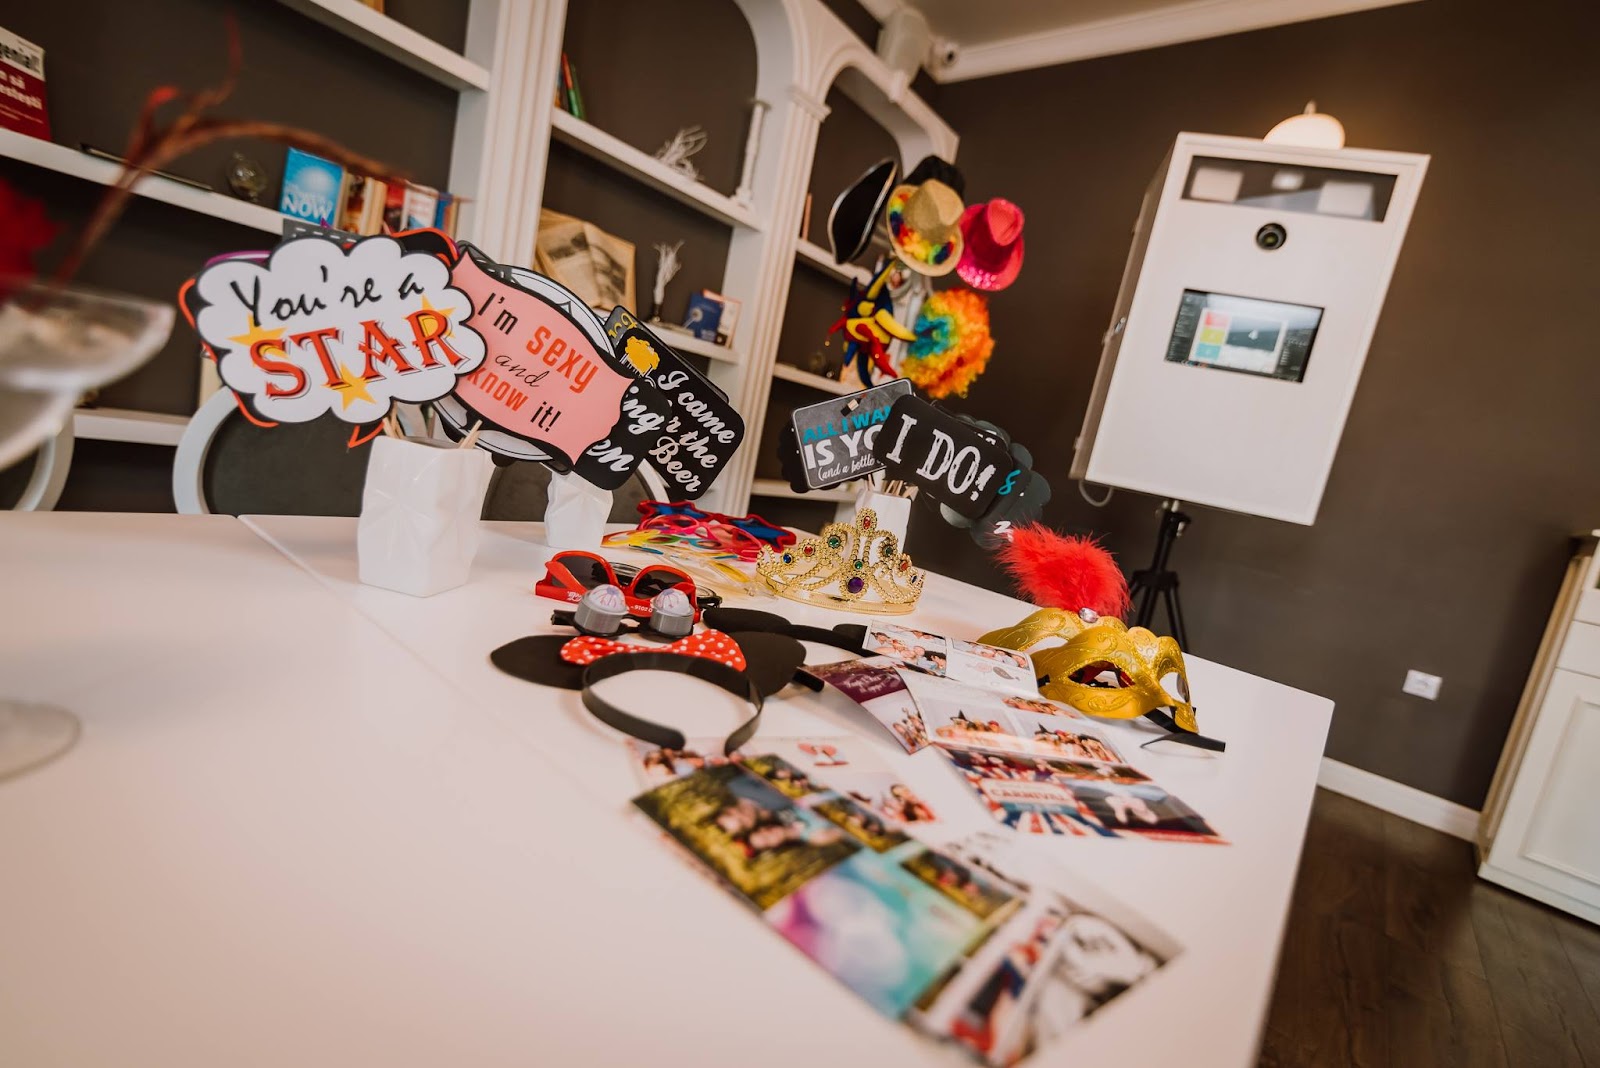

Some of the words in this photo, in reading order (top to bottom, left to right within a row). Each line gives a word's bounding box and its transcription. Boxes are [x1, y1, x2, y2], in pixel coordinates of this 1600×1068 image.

[281, 191, 334, 220] NOW
[230, 265, 381, 327] You're
[398, 272, 424, 300] a
[249, 309, 470, 400] STAR
[478, 292, 518, 335] I'm
[526, 325, 599, 394] sexy
[495, 355, 550, 387] and
[467, 367, 529, 412] know
[530, 401, 561, 432] it!
[677, 391, 736, 443] came
[679, 430, 718, 468] the
[803, 422, 838, 444] ALL
[841, 418, 849, 433] I
[804, 439, 835, 470] IS
[648, 436, 702, 492] Beer
[842, 465, 850, 474] a
[851, 453, 875, 473] bottle
[886, 413, 918, 464] I
[916, 428, 996, 502] DO!
